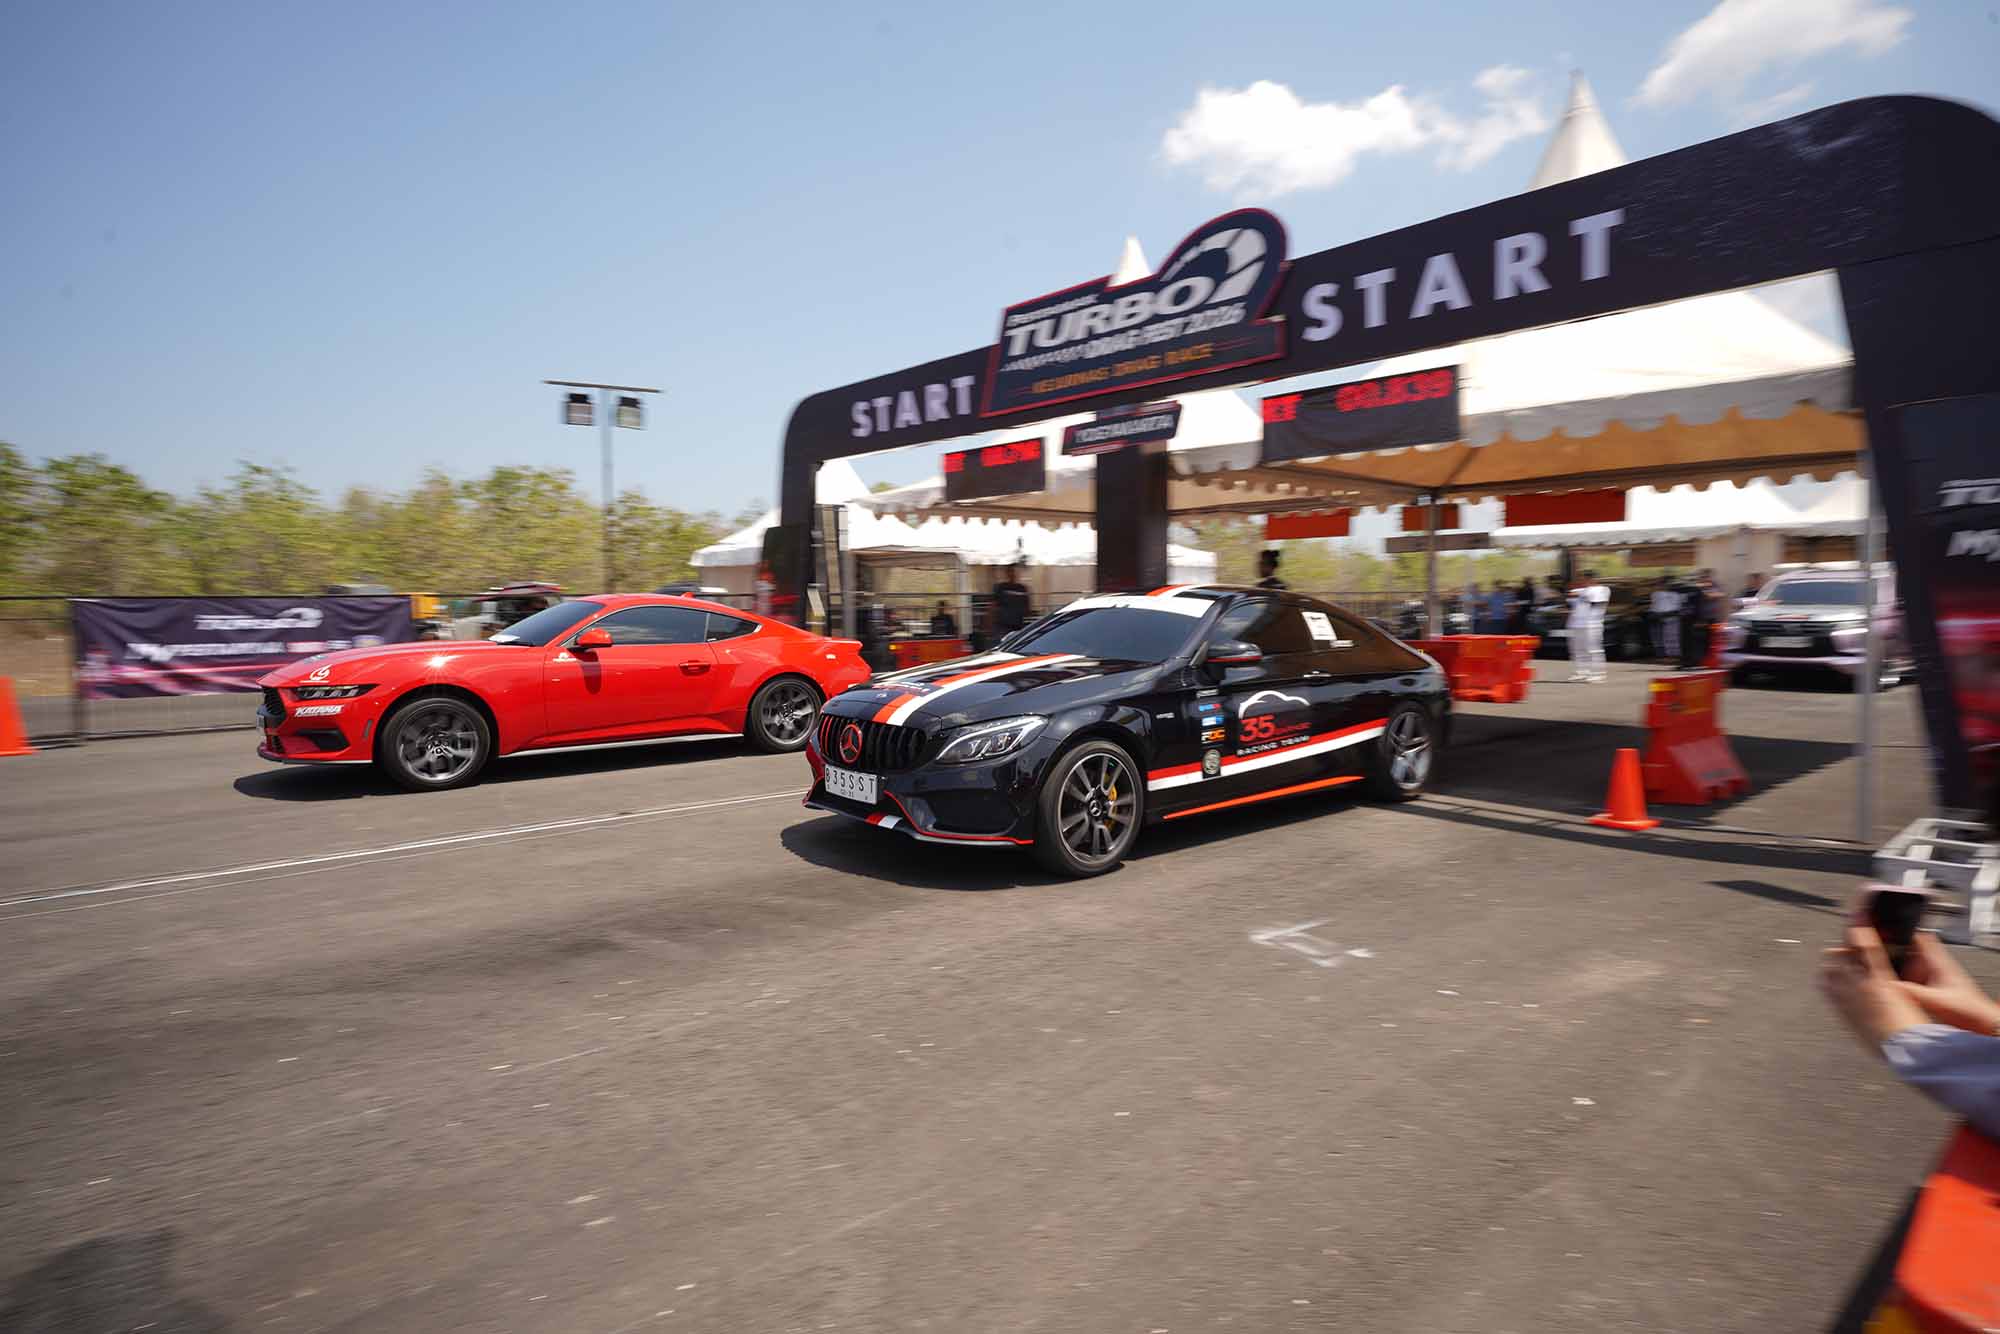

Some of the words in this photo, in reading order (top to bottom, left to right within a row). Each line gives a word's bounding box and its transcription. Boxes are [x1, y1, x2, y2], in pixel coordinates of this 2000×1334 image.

[1301, 208, 1625, 342] START
[1004, 276, 1215, 357] TURBO
[852, 375, 975, 438] START
[1239, 713, 1276, 742] 35
